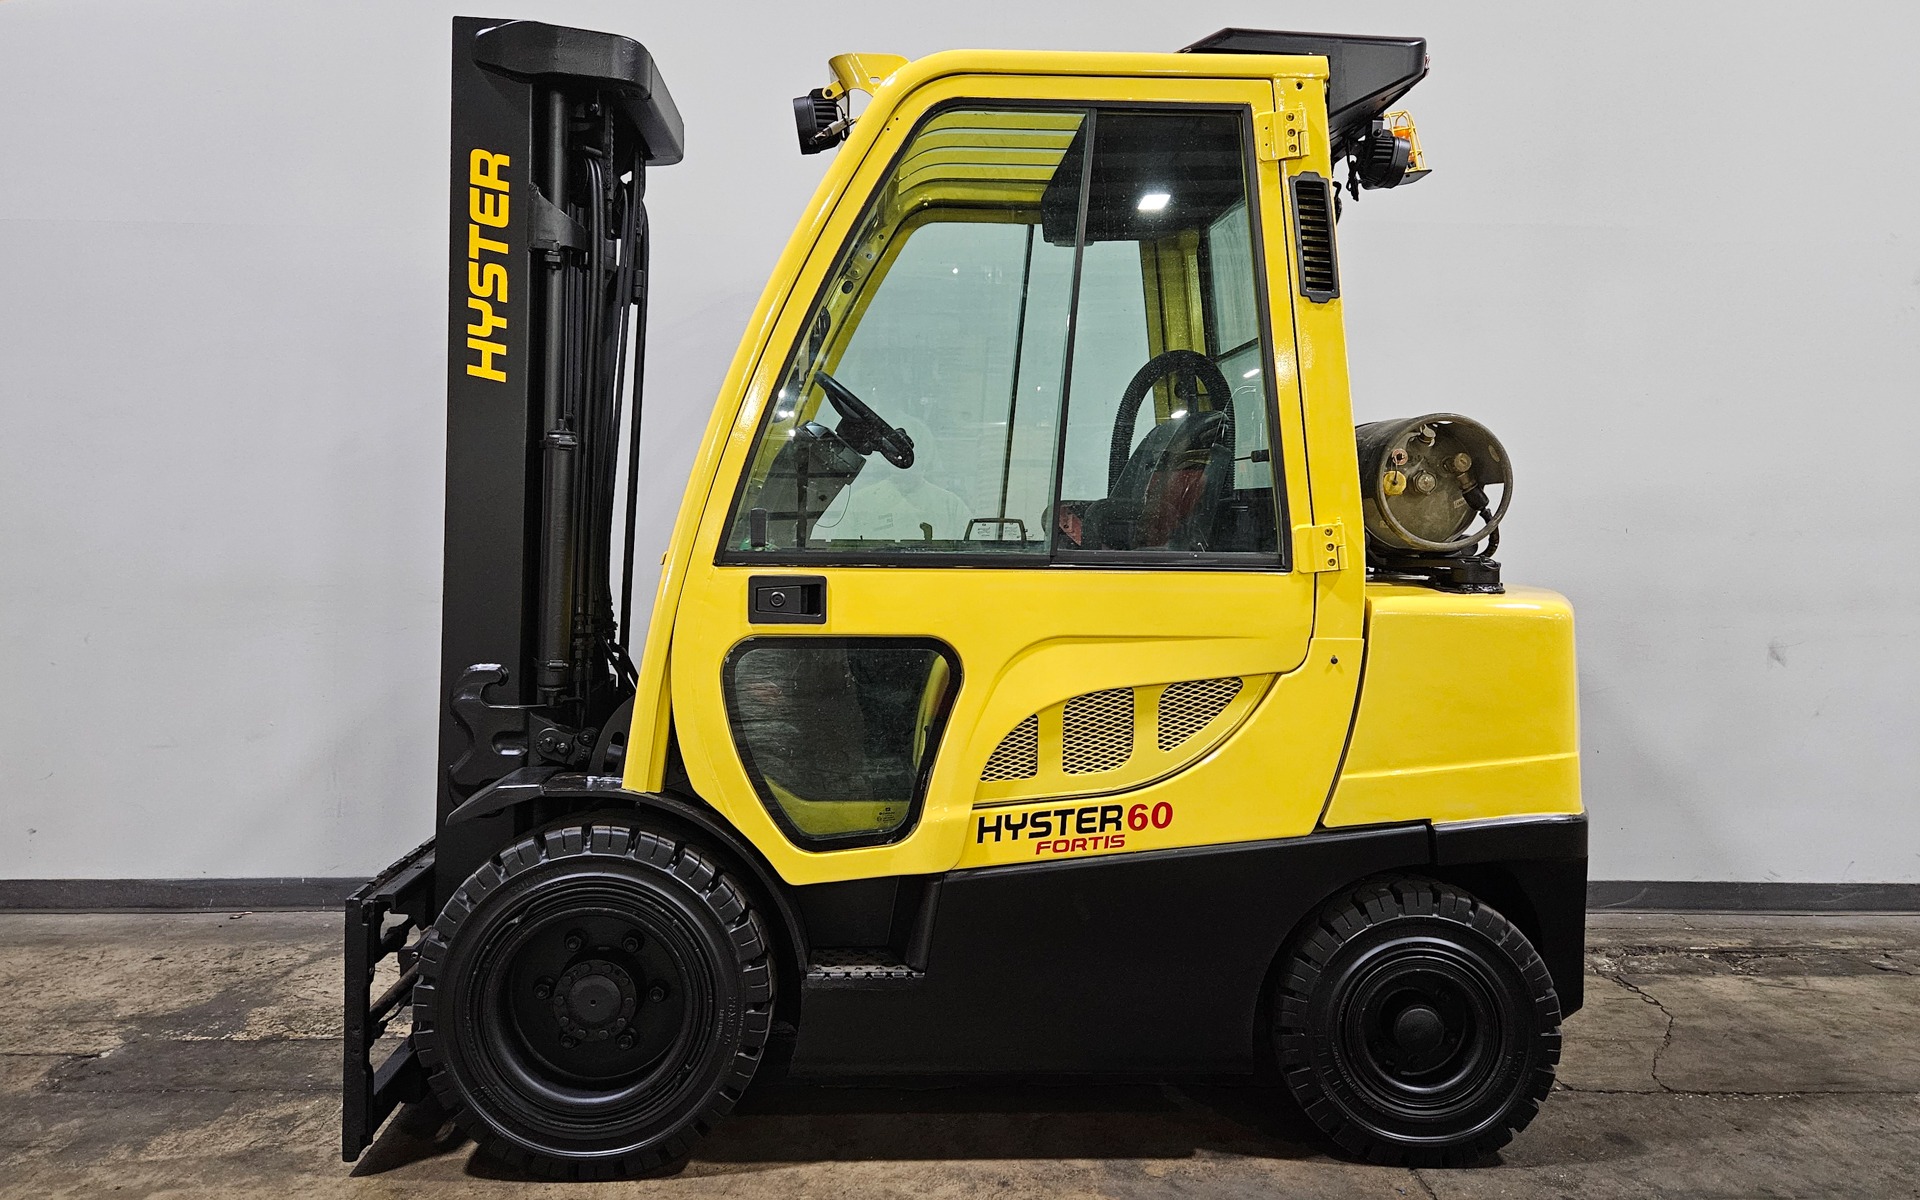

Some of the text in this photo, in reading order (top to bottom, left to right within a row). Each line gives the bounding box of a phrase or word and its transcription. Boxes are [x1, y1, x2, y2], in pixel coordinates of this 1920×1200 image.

[466, 148, 511, 383] HYSTER
[976, 801, 1174, 844] HYSTER 60
[1035, 834, 1126, 855] FORTIS
